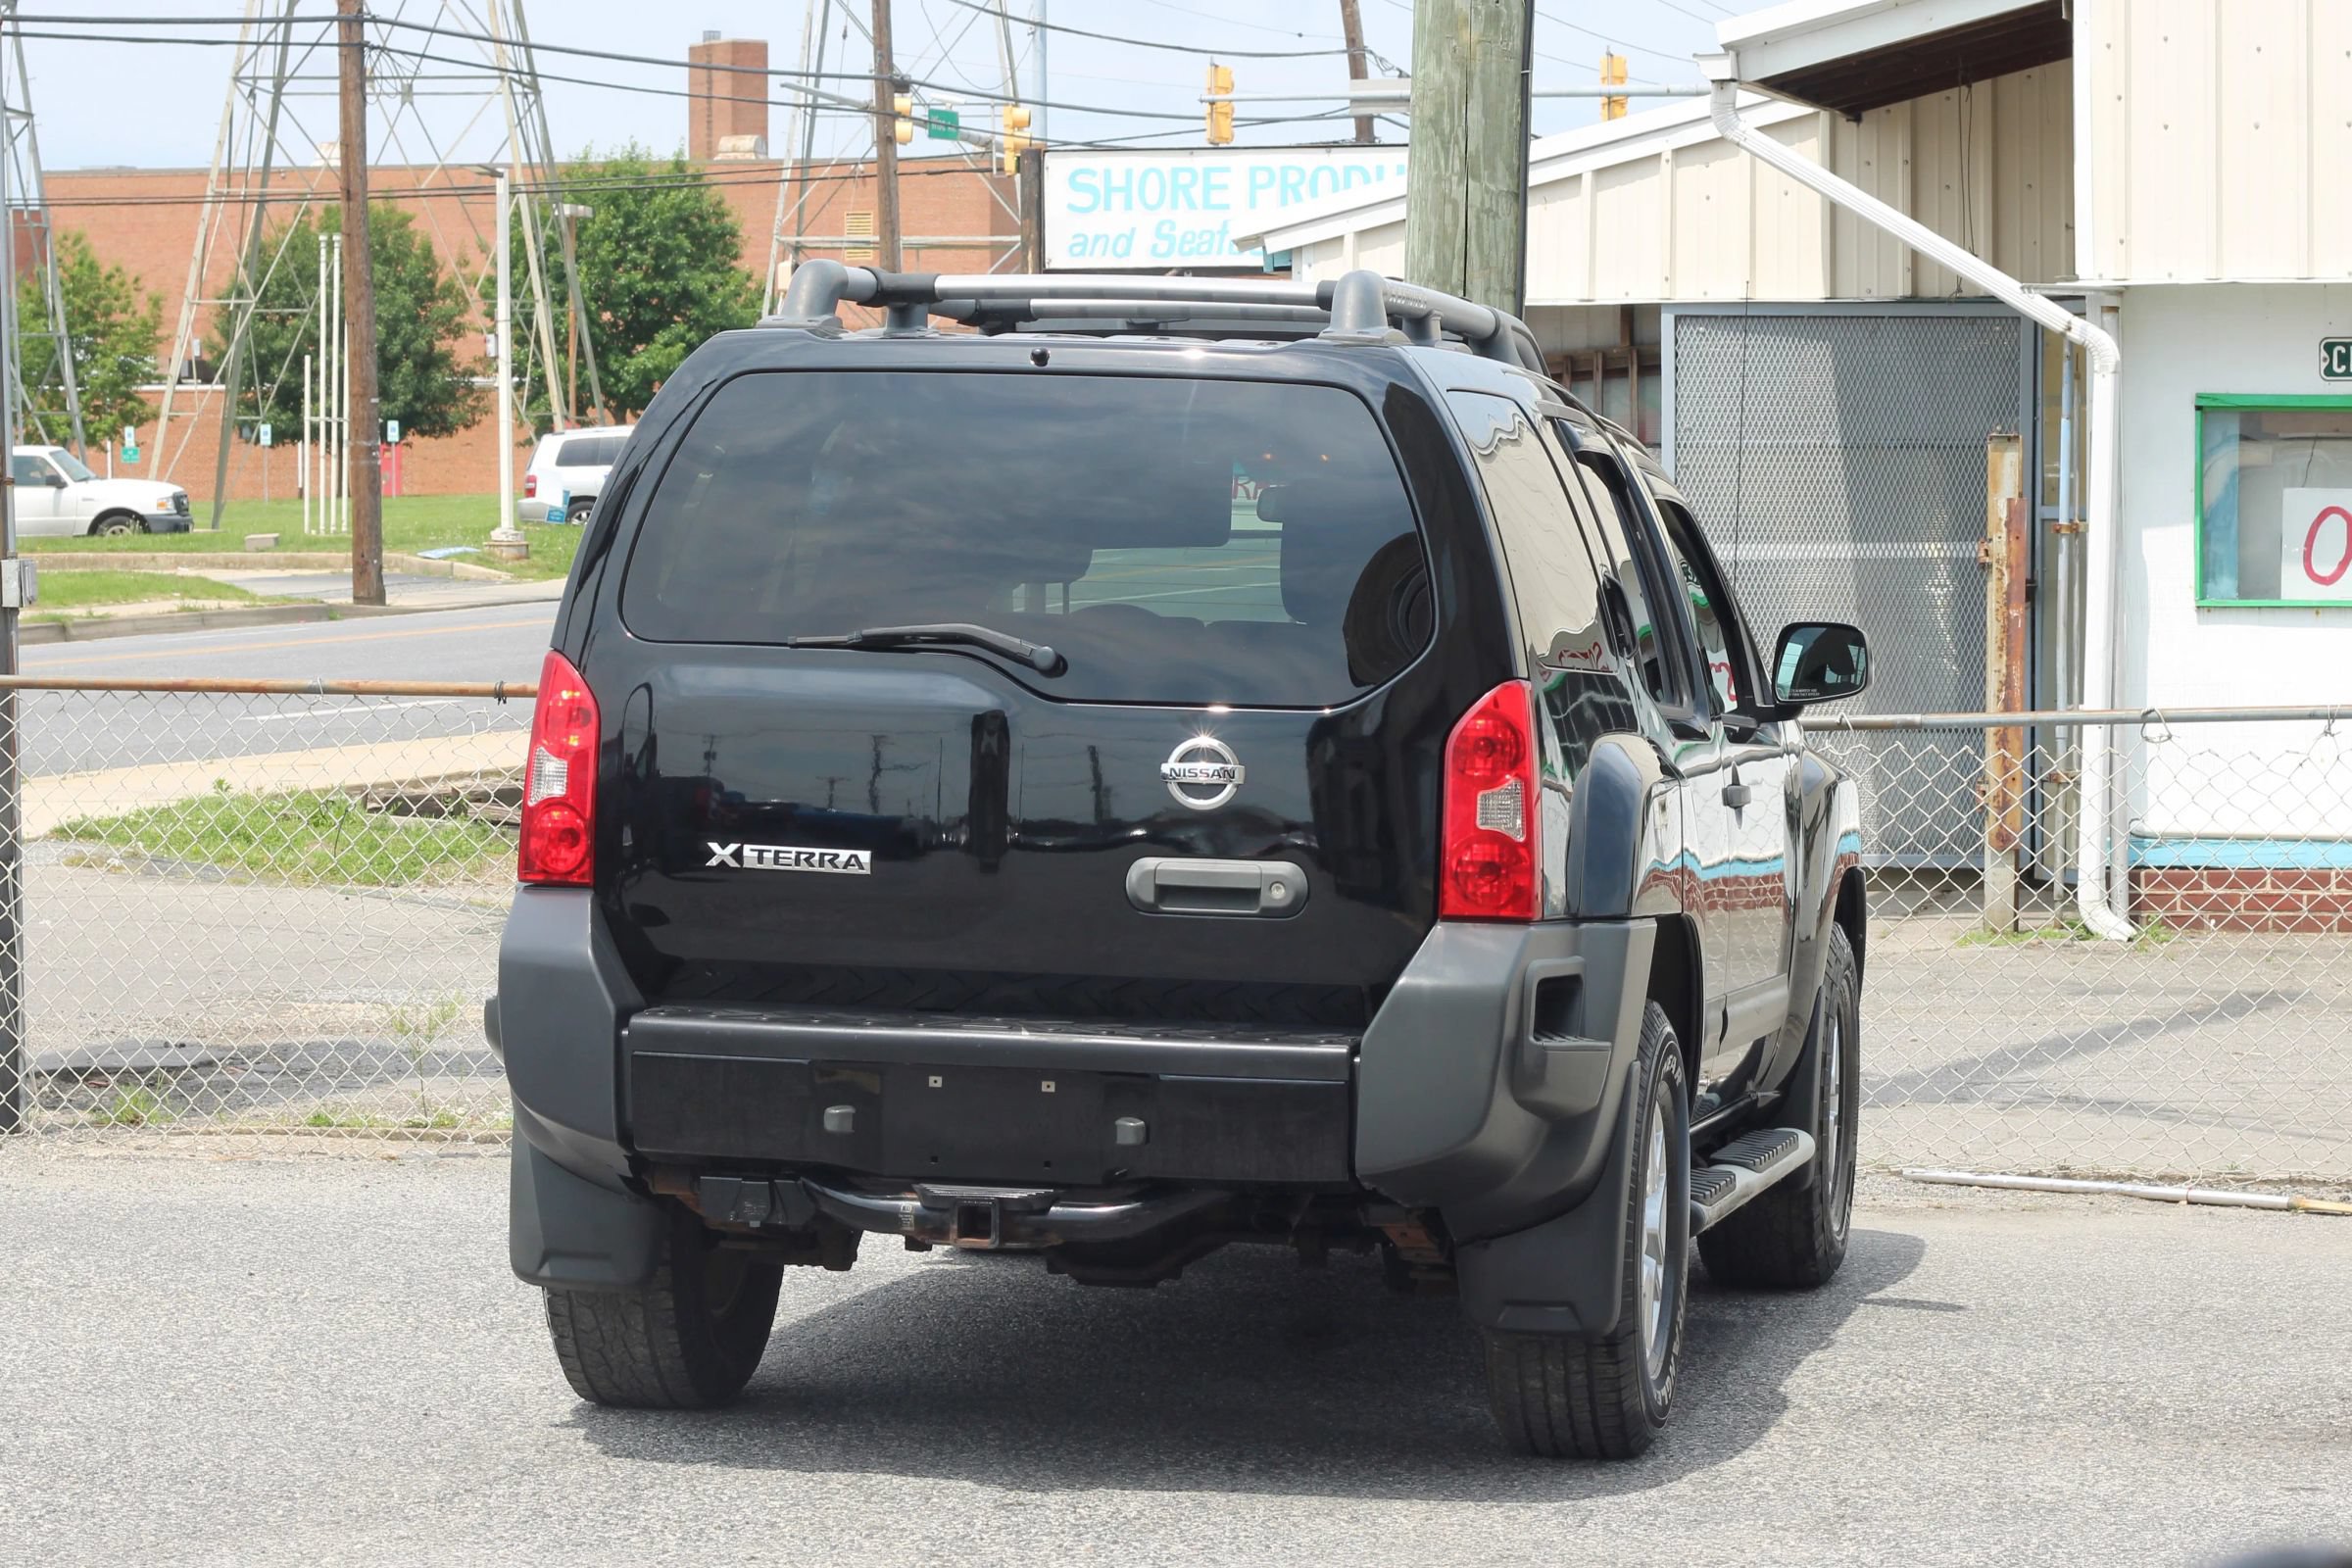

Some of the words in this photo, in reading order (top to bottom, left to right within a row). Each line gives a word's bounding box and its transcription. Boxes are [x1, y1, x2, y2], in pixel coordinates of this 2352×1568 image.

[1067, 167, 1231, 214] SHORE
[1068, 226, 1137, 258] and
[1150, 219, 1263, 258] Seaf
[2332, 345, 2352, 373] C
[1169, 767, 1235, 780] NISSAN
[705, 842, 869, 872] XTERRA
